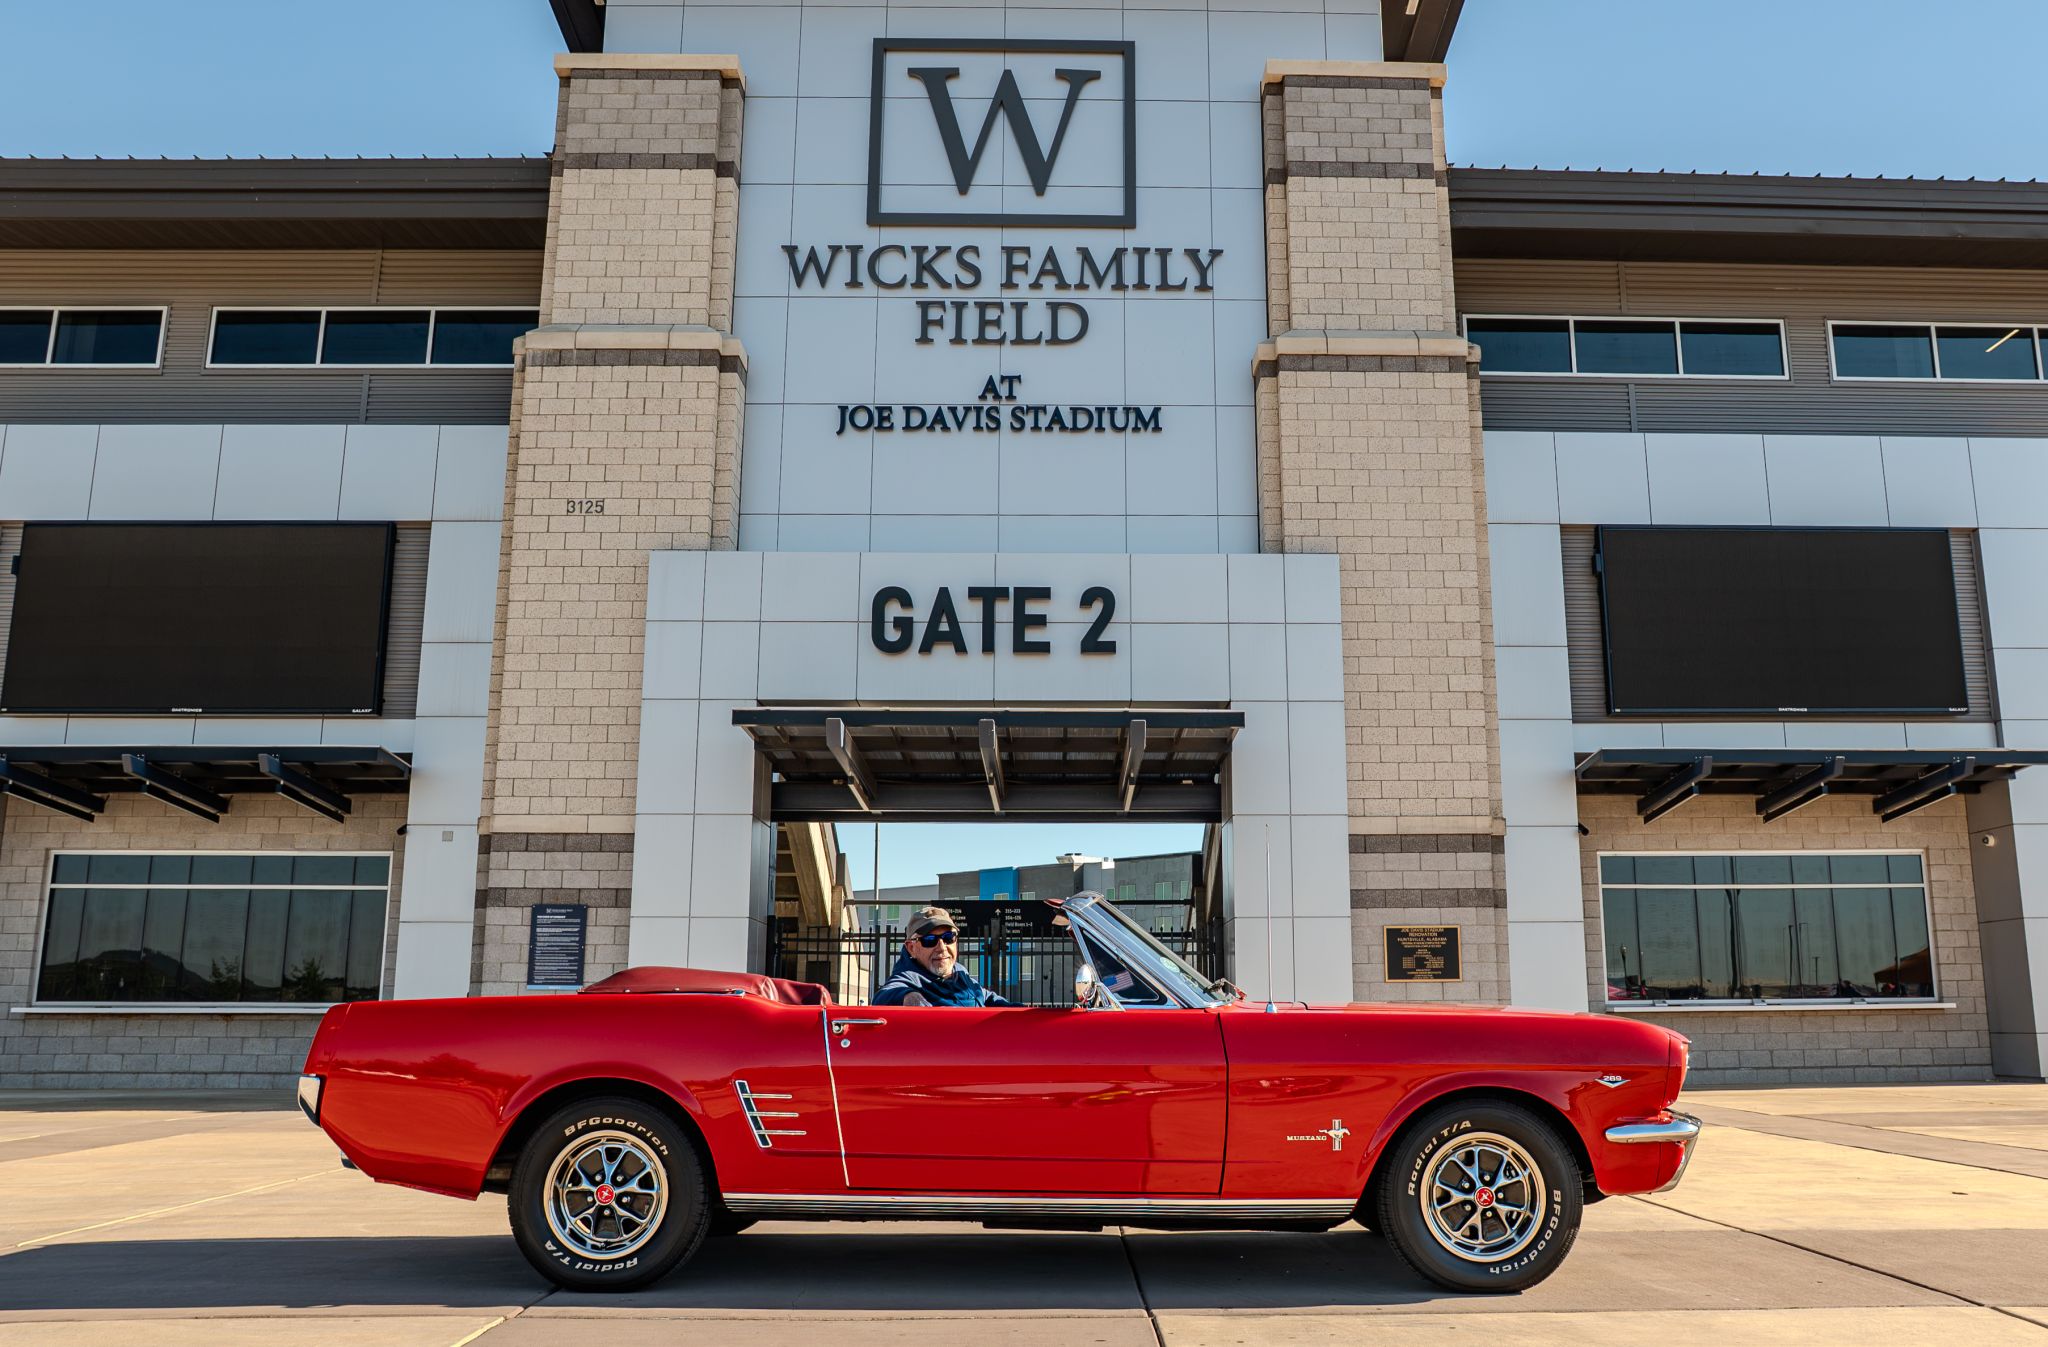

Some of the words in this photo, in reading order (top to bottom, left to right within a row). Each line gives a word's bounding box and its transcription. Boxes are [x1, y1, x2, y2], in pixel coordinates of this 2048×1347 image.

[907, 67, 1101, 196] W
[781, 244, 982, 290] WICKS
[1000, 246, 1224, 292] FAMILY
[914, 300, 1090, 346] FIELD
[978, 375, 1022, 401] AT
[836, 405, 894, 436] JOE
[902, 406, 1001, 432] DAVIS
[1010, 406, 1162, 432] STADIUM
[567, 500, 603, 514] 3125
[871, 586, 1052, 655] GATE
[1079, 586, 1117, 655] 2
[564, 1117, 669, 1156] BFGoodrich
[1407, 1137, 1438, 1196] Radial
[1440, 1120, 1472, 1137] T/A
[544, 1239, 571, 1265] T/A
[1489, 1189, 1562, 1274] BFGoodrich
[575, 1257, 638, 1272] Radial
